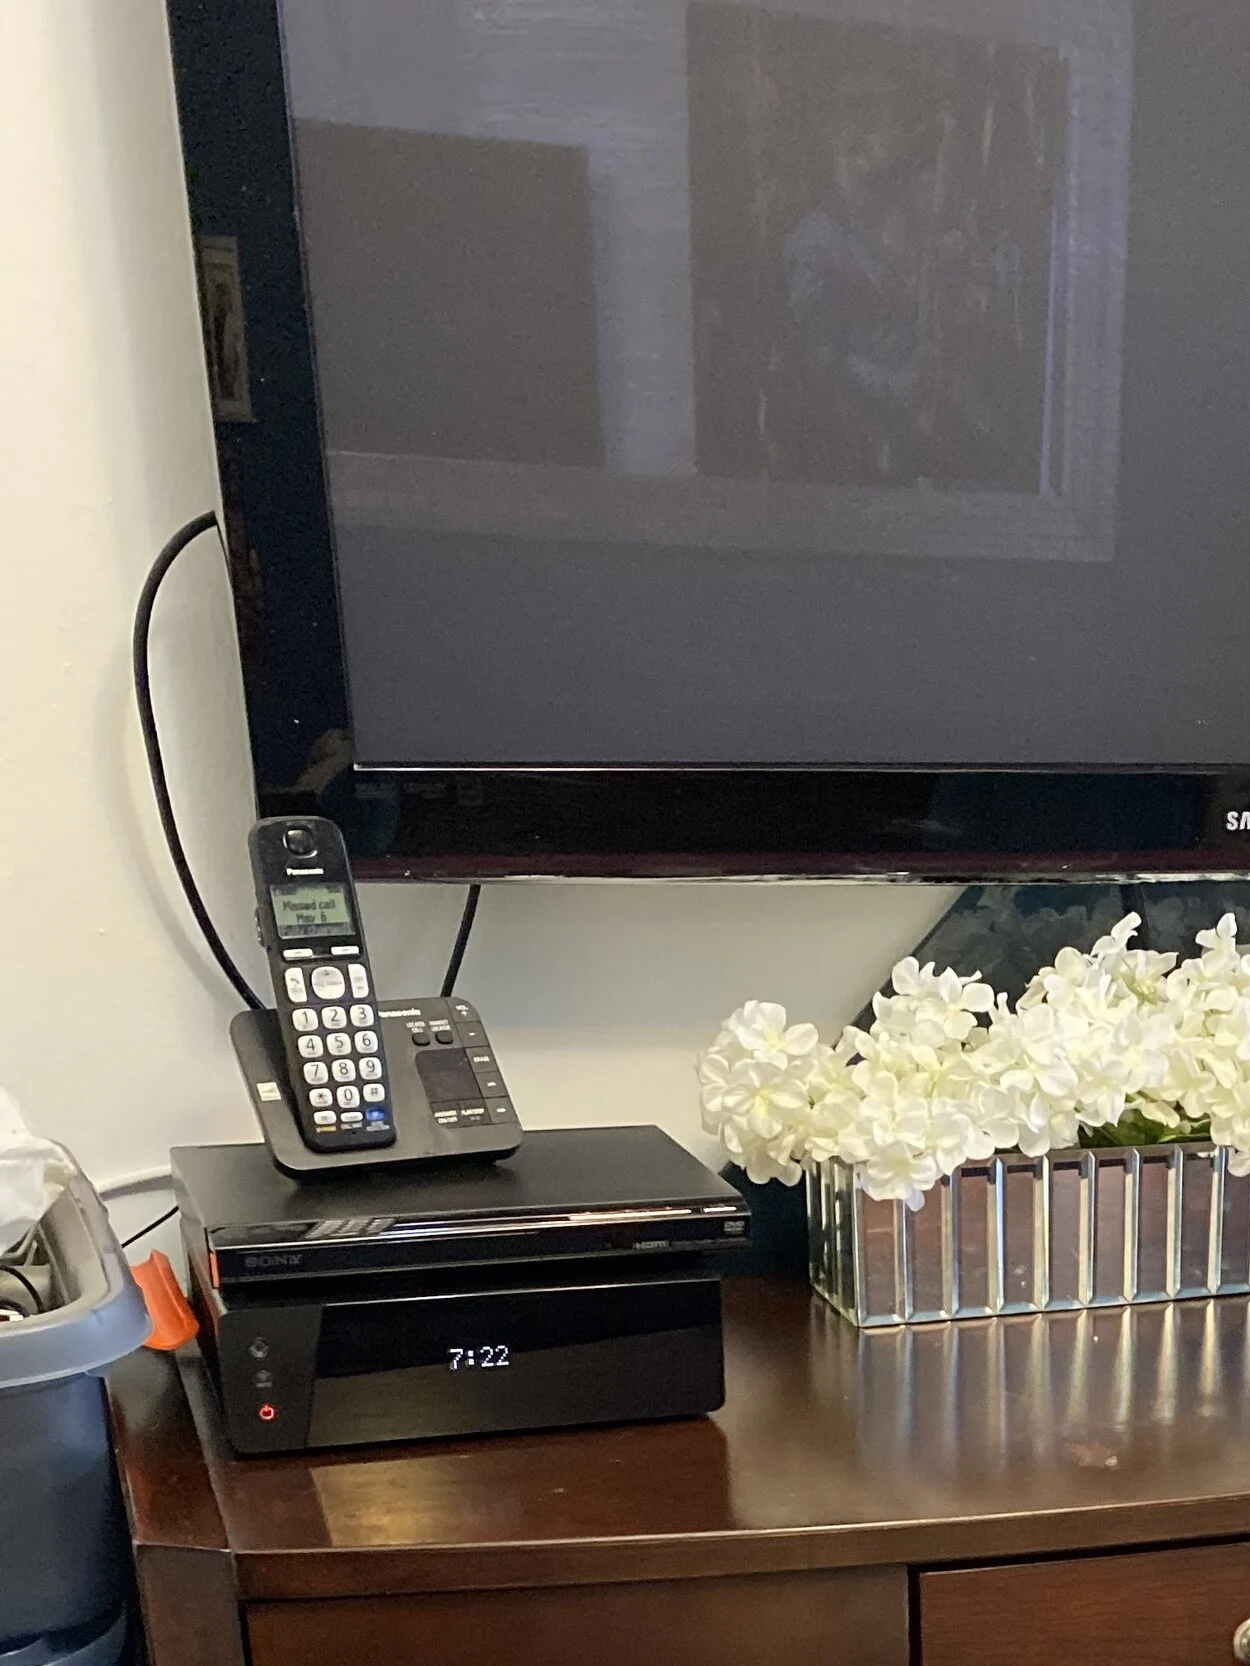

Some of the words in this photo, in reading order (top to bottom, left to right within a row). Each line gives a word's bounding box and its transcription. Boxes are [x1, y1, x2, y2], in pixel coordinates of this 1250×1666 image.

[318, 899, 336, 911] call
[295, 913, 316, 925] May
[301, 1010, 309, 1024] 1
[330, 1008, 339, 1022] 2
[358, 1006, 366, 1020] 3
[306, 1037, 315, 1052] 4
[335, 1035, 344, 1049] 5
[362, 1033, 371, 1047] 6
[310, 1063, 319, 1078] 7
[339, 1061, 349, 1076] 8
[366, 1059, 375, 1073] 9
[344, 1088, 353, 1102] 0
[244, 1254, 302, 1267] SONY
[447, 1344, 511, 1371] 7:22
